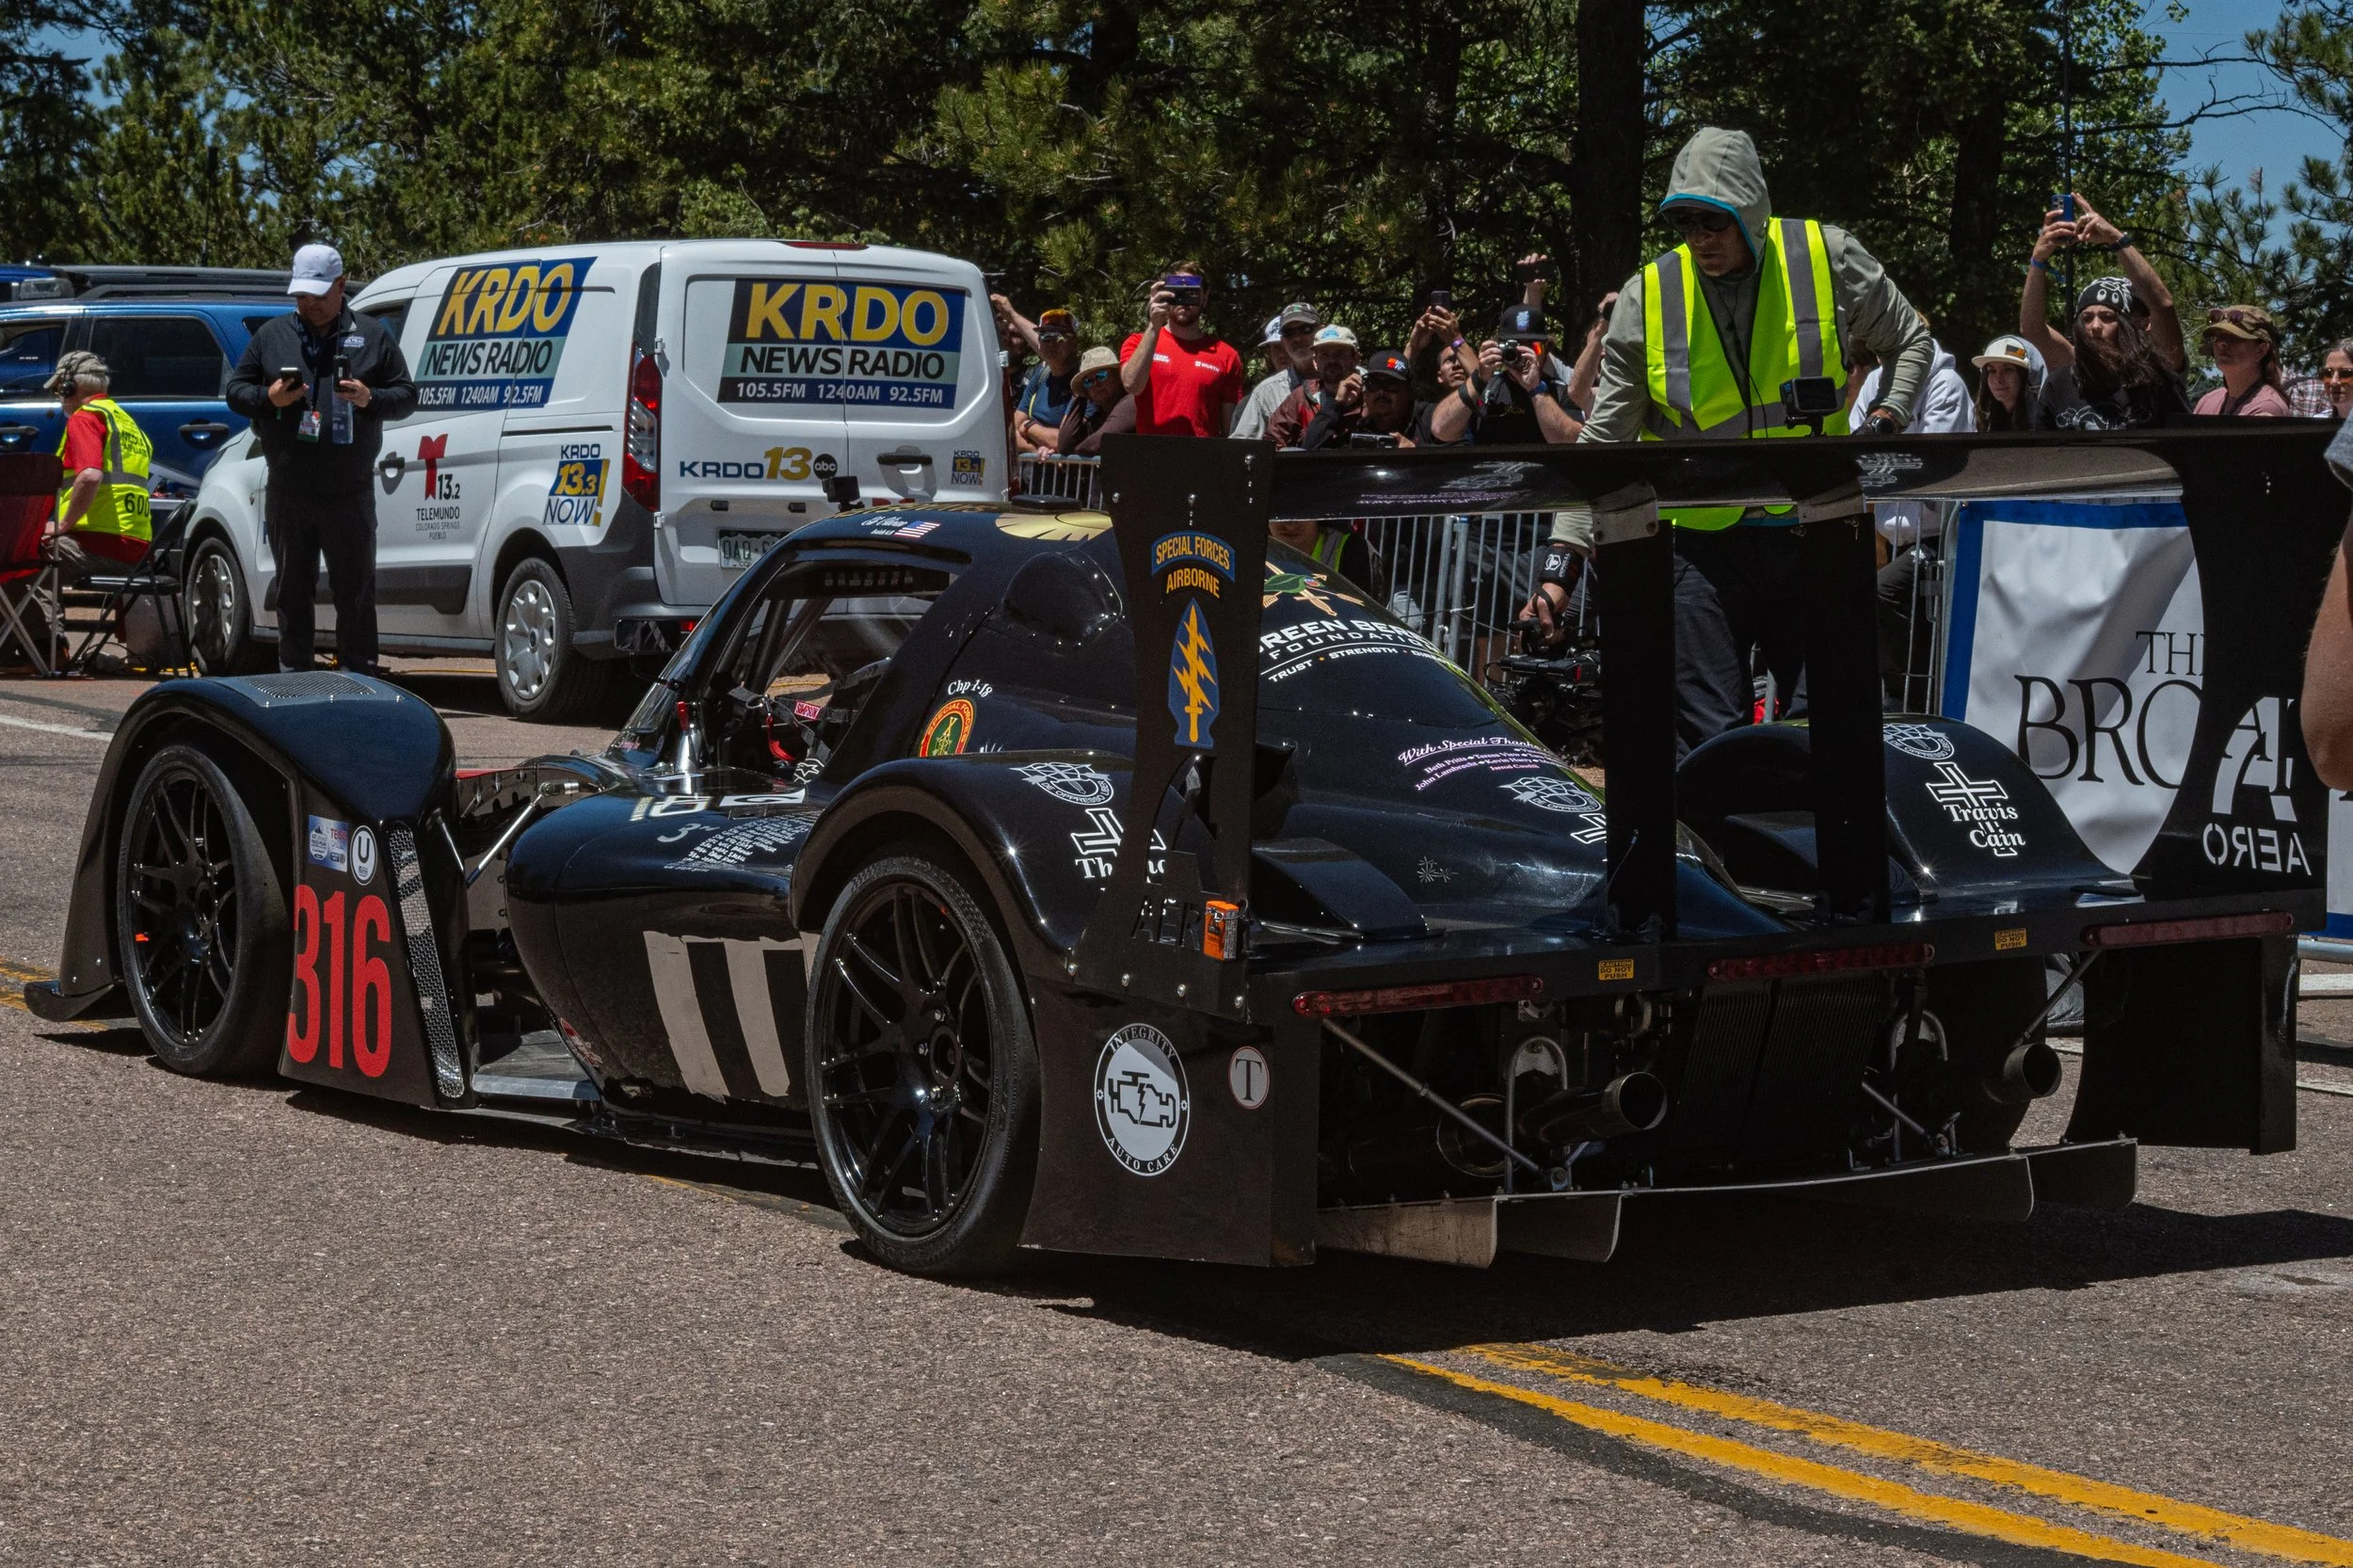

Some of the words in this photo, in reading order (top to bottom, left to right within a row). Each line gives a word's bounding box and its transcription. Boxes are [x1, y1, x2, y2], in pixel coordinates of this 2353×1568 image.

[437, 264, 574, 335] KRDO
[745, 283, 950, 346] KRDO
[740, 346, 841, 376] NEWS
[848, 349, 945, 379] RADIO
[418, 386, 456, 405] 105.5FM
[461, 386, 501, 404] 1240AM
[503, 386, 544, 404] 92.5FM
[737, 383, 806, 399] 105.5FM
[817, 384, 880, 401] 1240AM
[889, 387, 943, 404] 92.5FM
[560, 443, 600, 459] KRDO
[680, 460, 764, 480] KRDO
[763, 447, 812, 481] 13
[814, 460, 837, 472] abc
[438, 474, 460, 500] 13.2
[554, 462, 598, 496] 13.3
[415, 522, 440, 532] COLORADO
[440, 521, 460, 531] SPRINGS
[416, 506, 460, 521] TELEMUNDO
[428, 532, 447, 540] PUEBLO
[1156, 536, 1193, 565] SPECIAL
[1194, 536, 1230, 570] FORCES
[1166, 568, 1220, 599] AIRBORNE
[1259, 618, 1349, 653] REEN
[1268, 659, 1313, 682] TRUST
[1329, 646, 1399, 659] STRENGTH
[2137, 631, 2204, 677] TH
[1398, 743, 1436, 764] With
[1437, 737, 1488, 752] Special
[1415, 776, 1437, 792] John
[1943, 802, 2019, 823] Travis
[358, 836, 369, 864] U
[1969, 828, 2025, 848] Cain
[1600, 960, 1632, 968] CAUTION
[287, 884, 392, 1078] 316
[1108, 1026, 1176, 1060] INTEGRITY
[1235, 1058, 1263, 1102] T
[1108, 1137, 1141, 1171] AUTO
[1147, 1143, 1177, 1173] CARE
